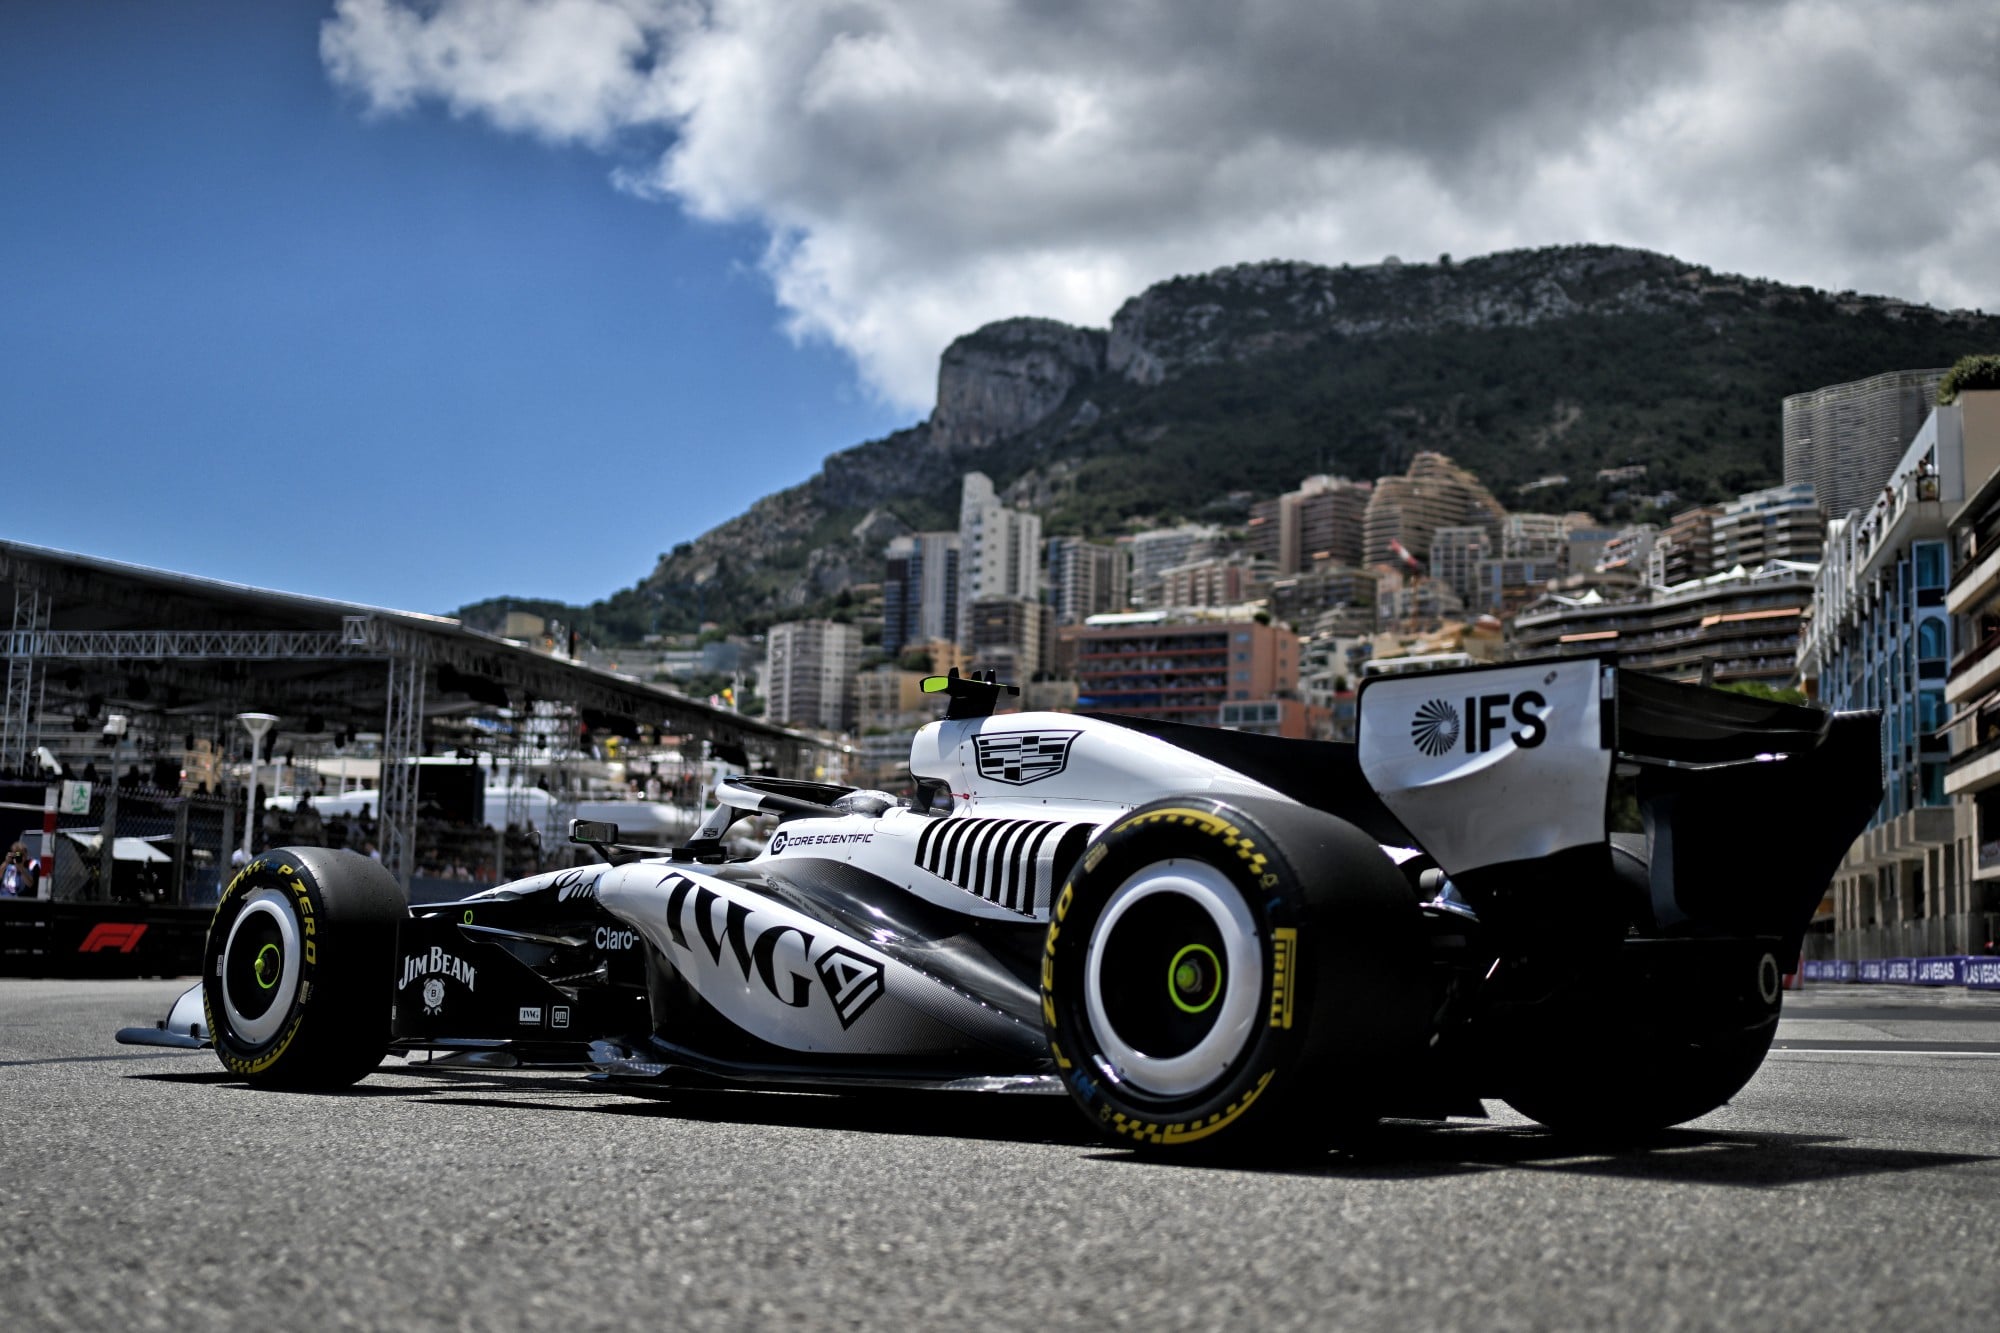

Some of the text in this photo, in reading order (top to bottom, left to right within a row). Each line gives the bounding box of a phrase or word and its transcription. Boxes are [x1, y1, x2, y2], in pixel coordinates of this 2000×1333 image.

[1465, 690, 1547, 753] IFS
[788, 834, 874, 847] CORE SCIENTIFIC
[277, 864, 317, 965] P ZERO
[656, 872, 815, 1008] TWG
[398, 946, 475, 992] JIM BEAM
[1269, 928, 1297, 1030] PIRELLI
